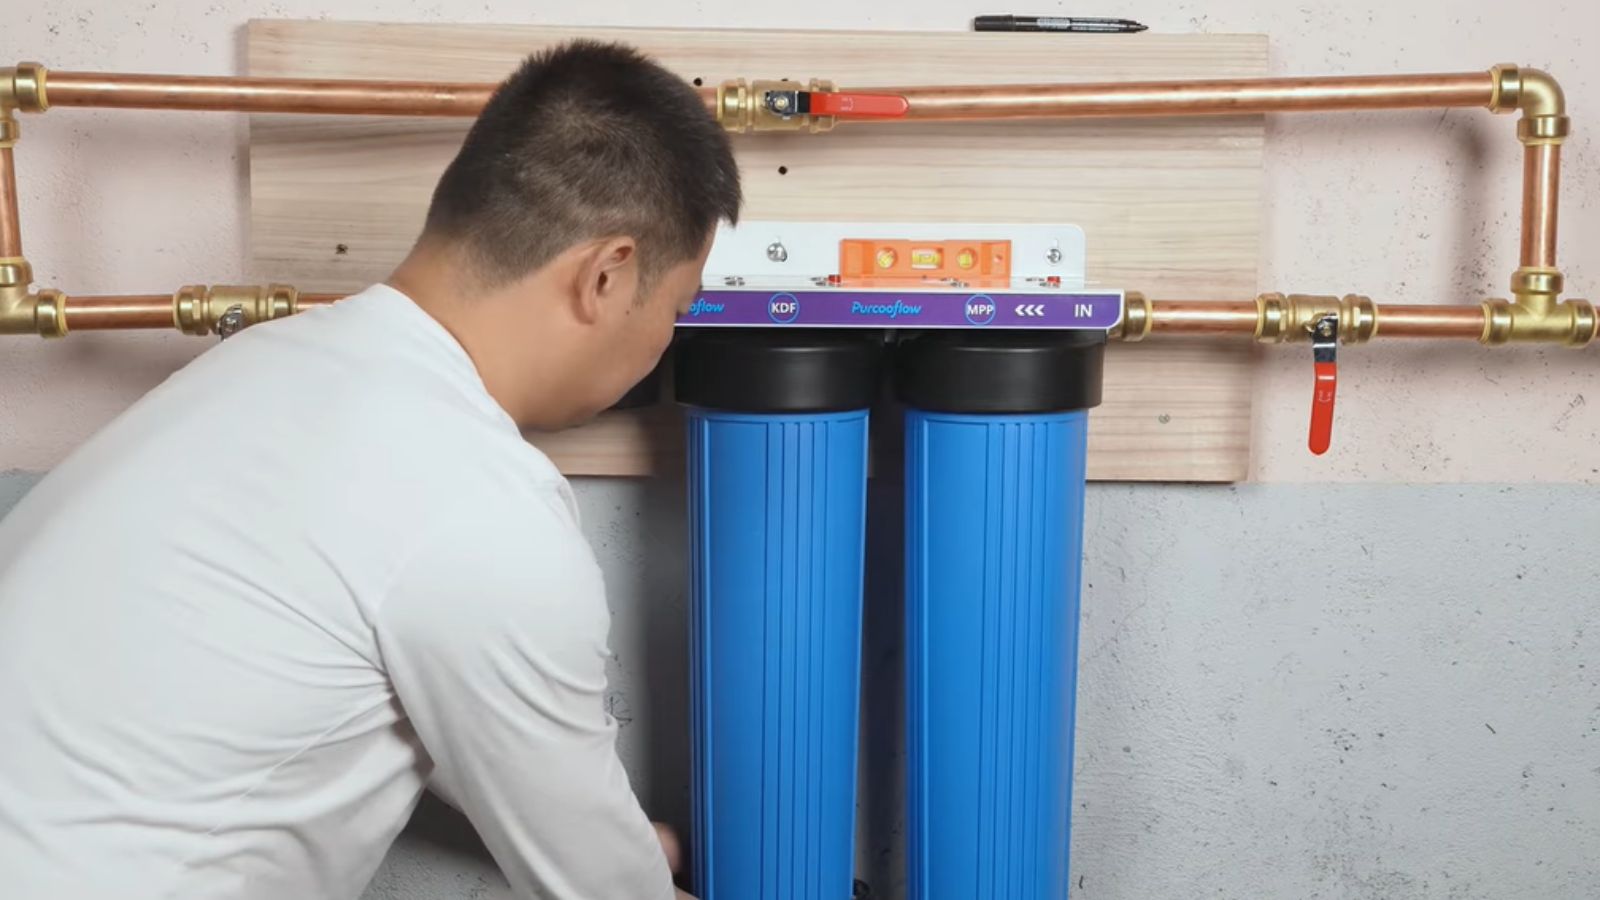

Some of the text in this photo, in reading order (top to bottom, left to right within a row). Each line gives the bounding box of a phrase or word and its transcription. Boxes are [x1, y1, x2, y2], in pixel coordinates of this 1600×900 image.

[689, 298, 725, 316] oflow
[771, 302, 797, 314] KDF
[851, 300, 922, 318] Purcooflow
[967, 304, 994, 315] MPP
[1074, 304, 1093, 318] IN
